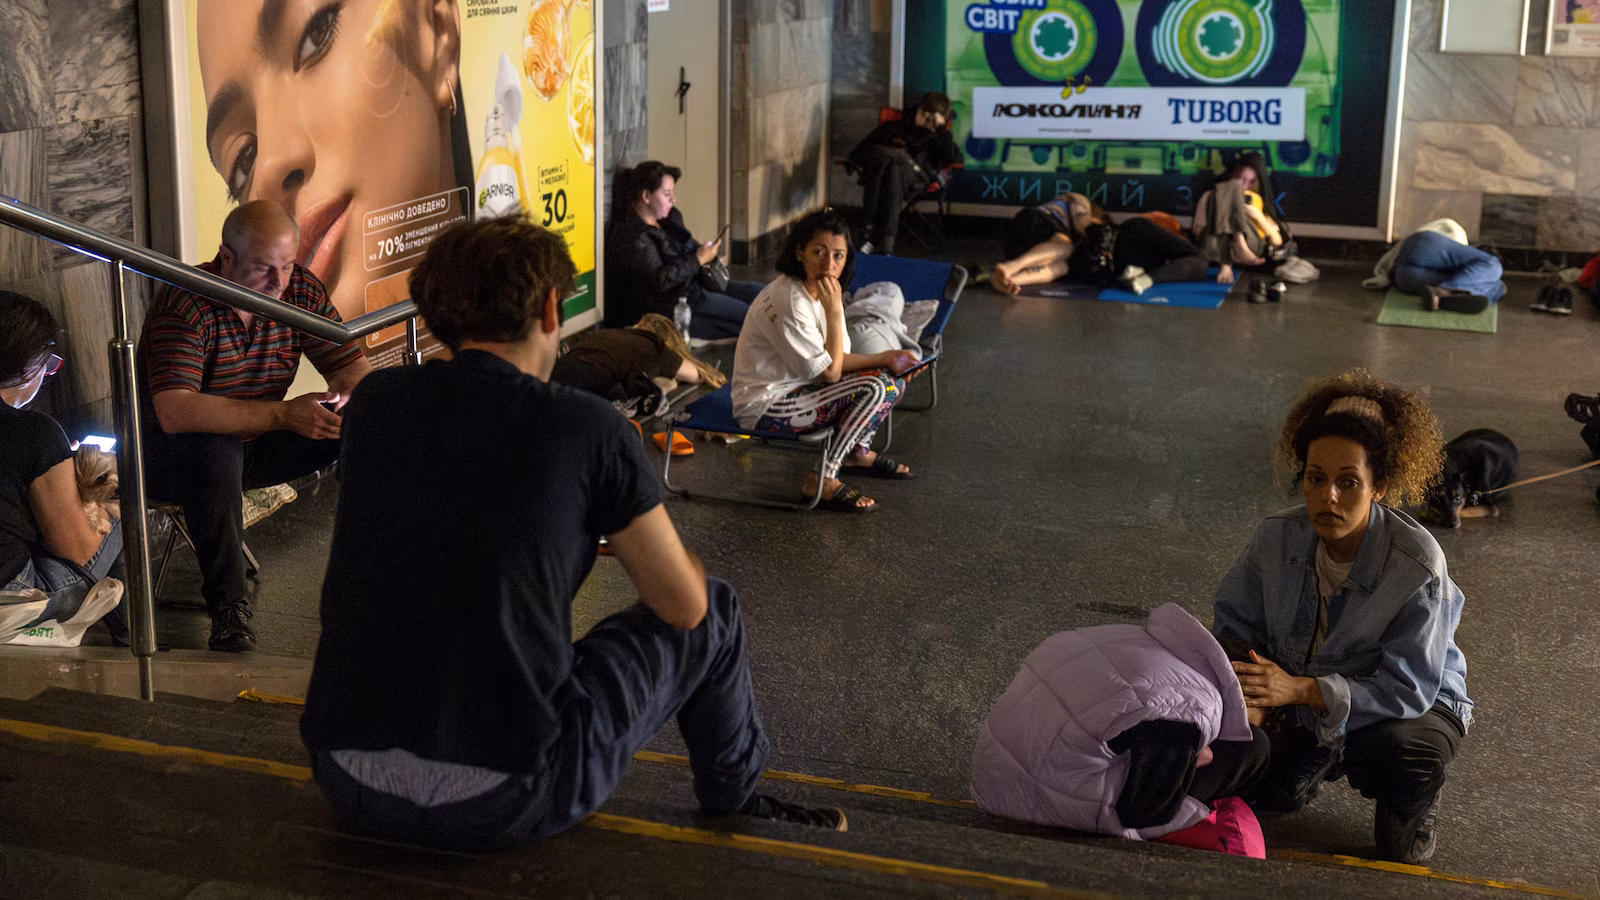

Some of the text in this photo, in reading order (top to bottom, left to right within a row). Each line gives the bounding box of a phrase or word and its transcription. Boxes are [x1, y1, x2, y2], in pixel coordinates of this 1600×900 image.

[968, 7, 1020, 30] СВІТ
[1168, 97, 1282, 126] TUBORG
[368, 198, 447, 229] КЛІНІЧНО ДОВЕДЕНО
[542, 188, 568, 228] 30
[377, 234, 405, 259] 70%
